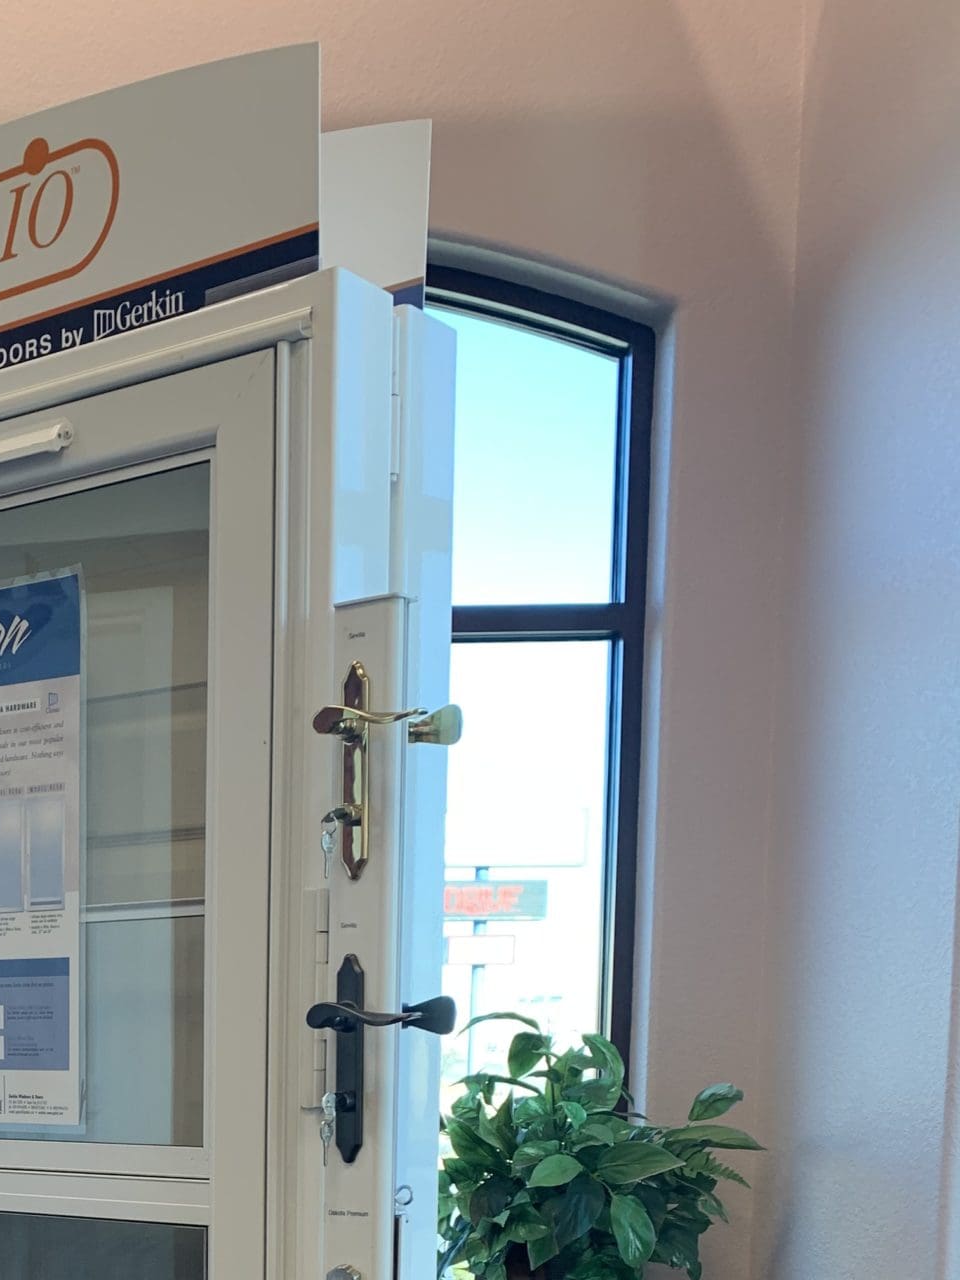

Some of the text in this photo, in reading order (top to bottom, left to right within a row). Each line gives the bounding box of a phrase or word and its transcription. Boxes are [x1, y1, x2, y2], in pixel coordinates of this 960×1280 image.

[60, 325, 84, 349] by
[114, 290, 185, 334] Gerkin
[6, 701, 37, 712] HARDWARE
